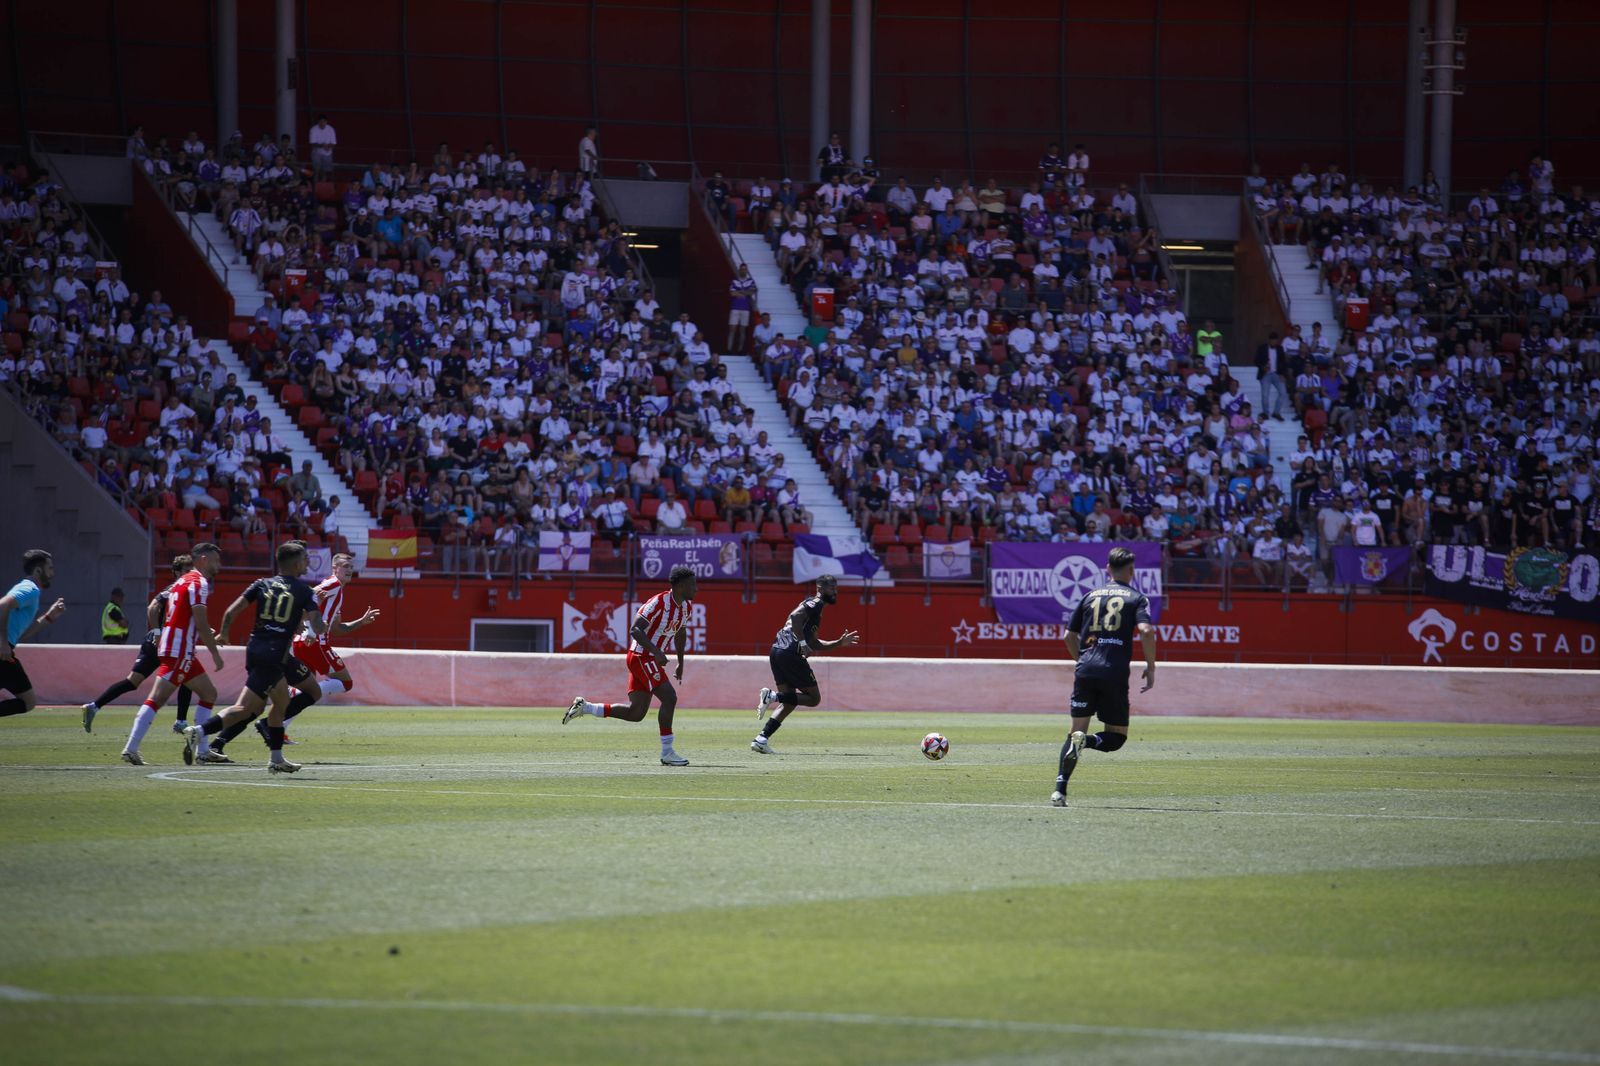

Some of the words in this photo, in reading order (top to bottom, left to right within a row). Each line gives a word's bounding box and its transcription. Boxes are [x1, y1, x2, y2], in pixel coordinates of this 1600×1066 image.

[640, 538, 669, 549] Peña
[669, 538, 695, 549] Real
[696, 537, 722, 548] Jaén
[685, 550, 699, 563] EL
[994, 571, 1049, 595] CRUZADA
[258, 588, 295, 623] 10
[1088, 596, 1125, 632] 18
[296, 662, 309, 677] 16
[644, 660, 659, 674] 11
